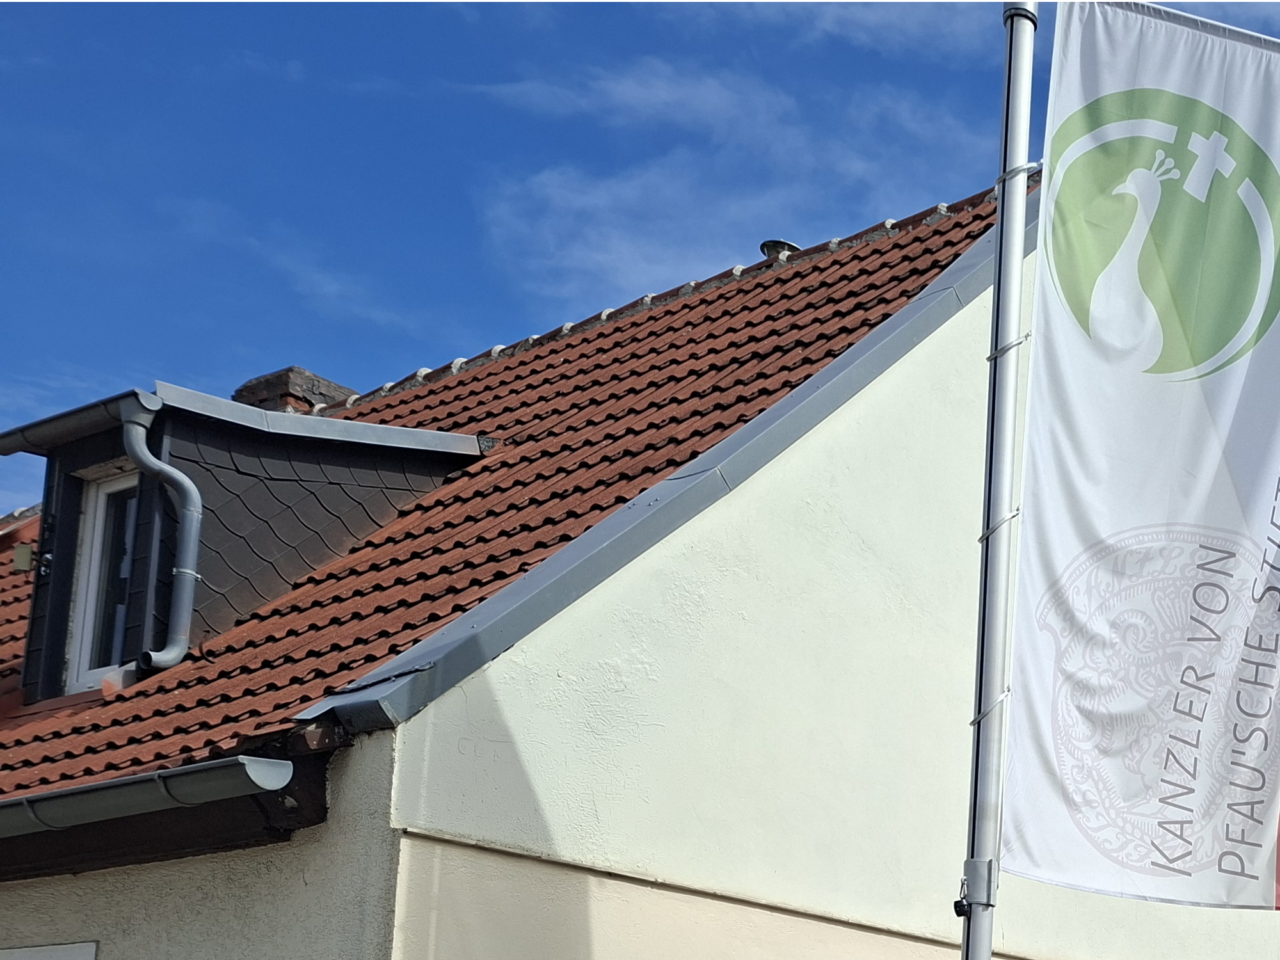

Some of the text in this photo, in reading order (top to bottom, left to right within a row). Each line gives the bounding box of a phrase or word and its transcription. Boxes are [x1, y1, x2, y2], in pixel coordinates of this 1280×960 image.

[1150, 543, 1237, 877] KANZLER VON
[1218, 626, 1280, 880] PFAU'SCHE
